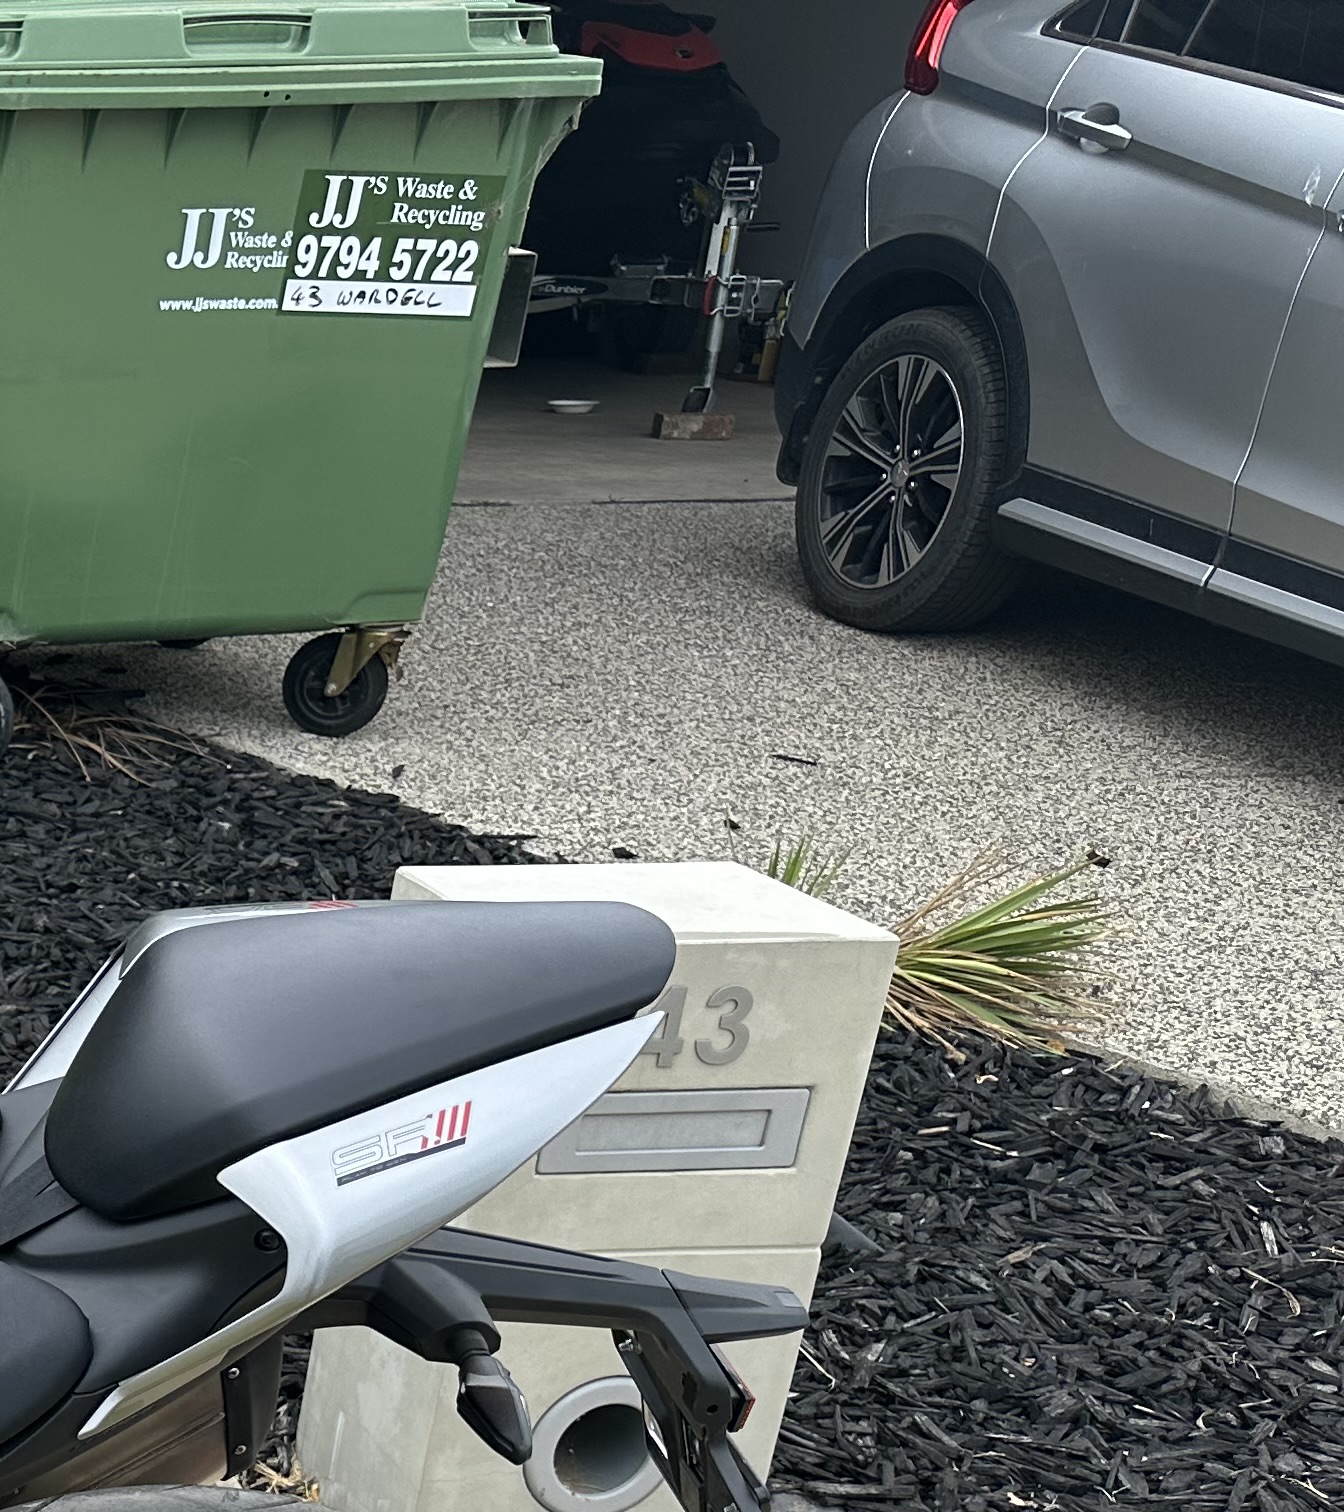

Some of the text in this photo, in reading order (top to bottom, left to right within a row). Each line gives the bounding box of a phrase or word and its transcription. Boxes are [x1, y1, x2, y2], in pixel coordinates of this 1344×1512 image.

[396, 177, 455, 201] Waste
[458, 179, 478, 200] &
[391, 203, 486, 230] Recycling
[229, 230, 294, 249] Waste &
[294, 235, 480, 283] 9794 5722
[290, 286, 322, 308] 43
[642, 984, 754, 1069] 43
